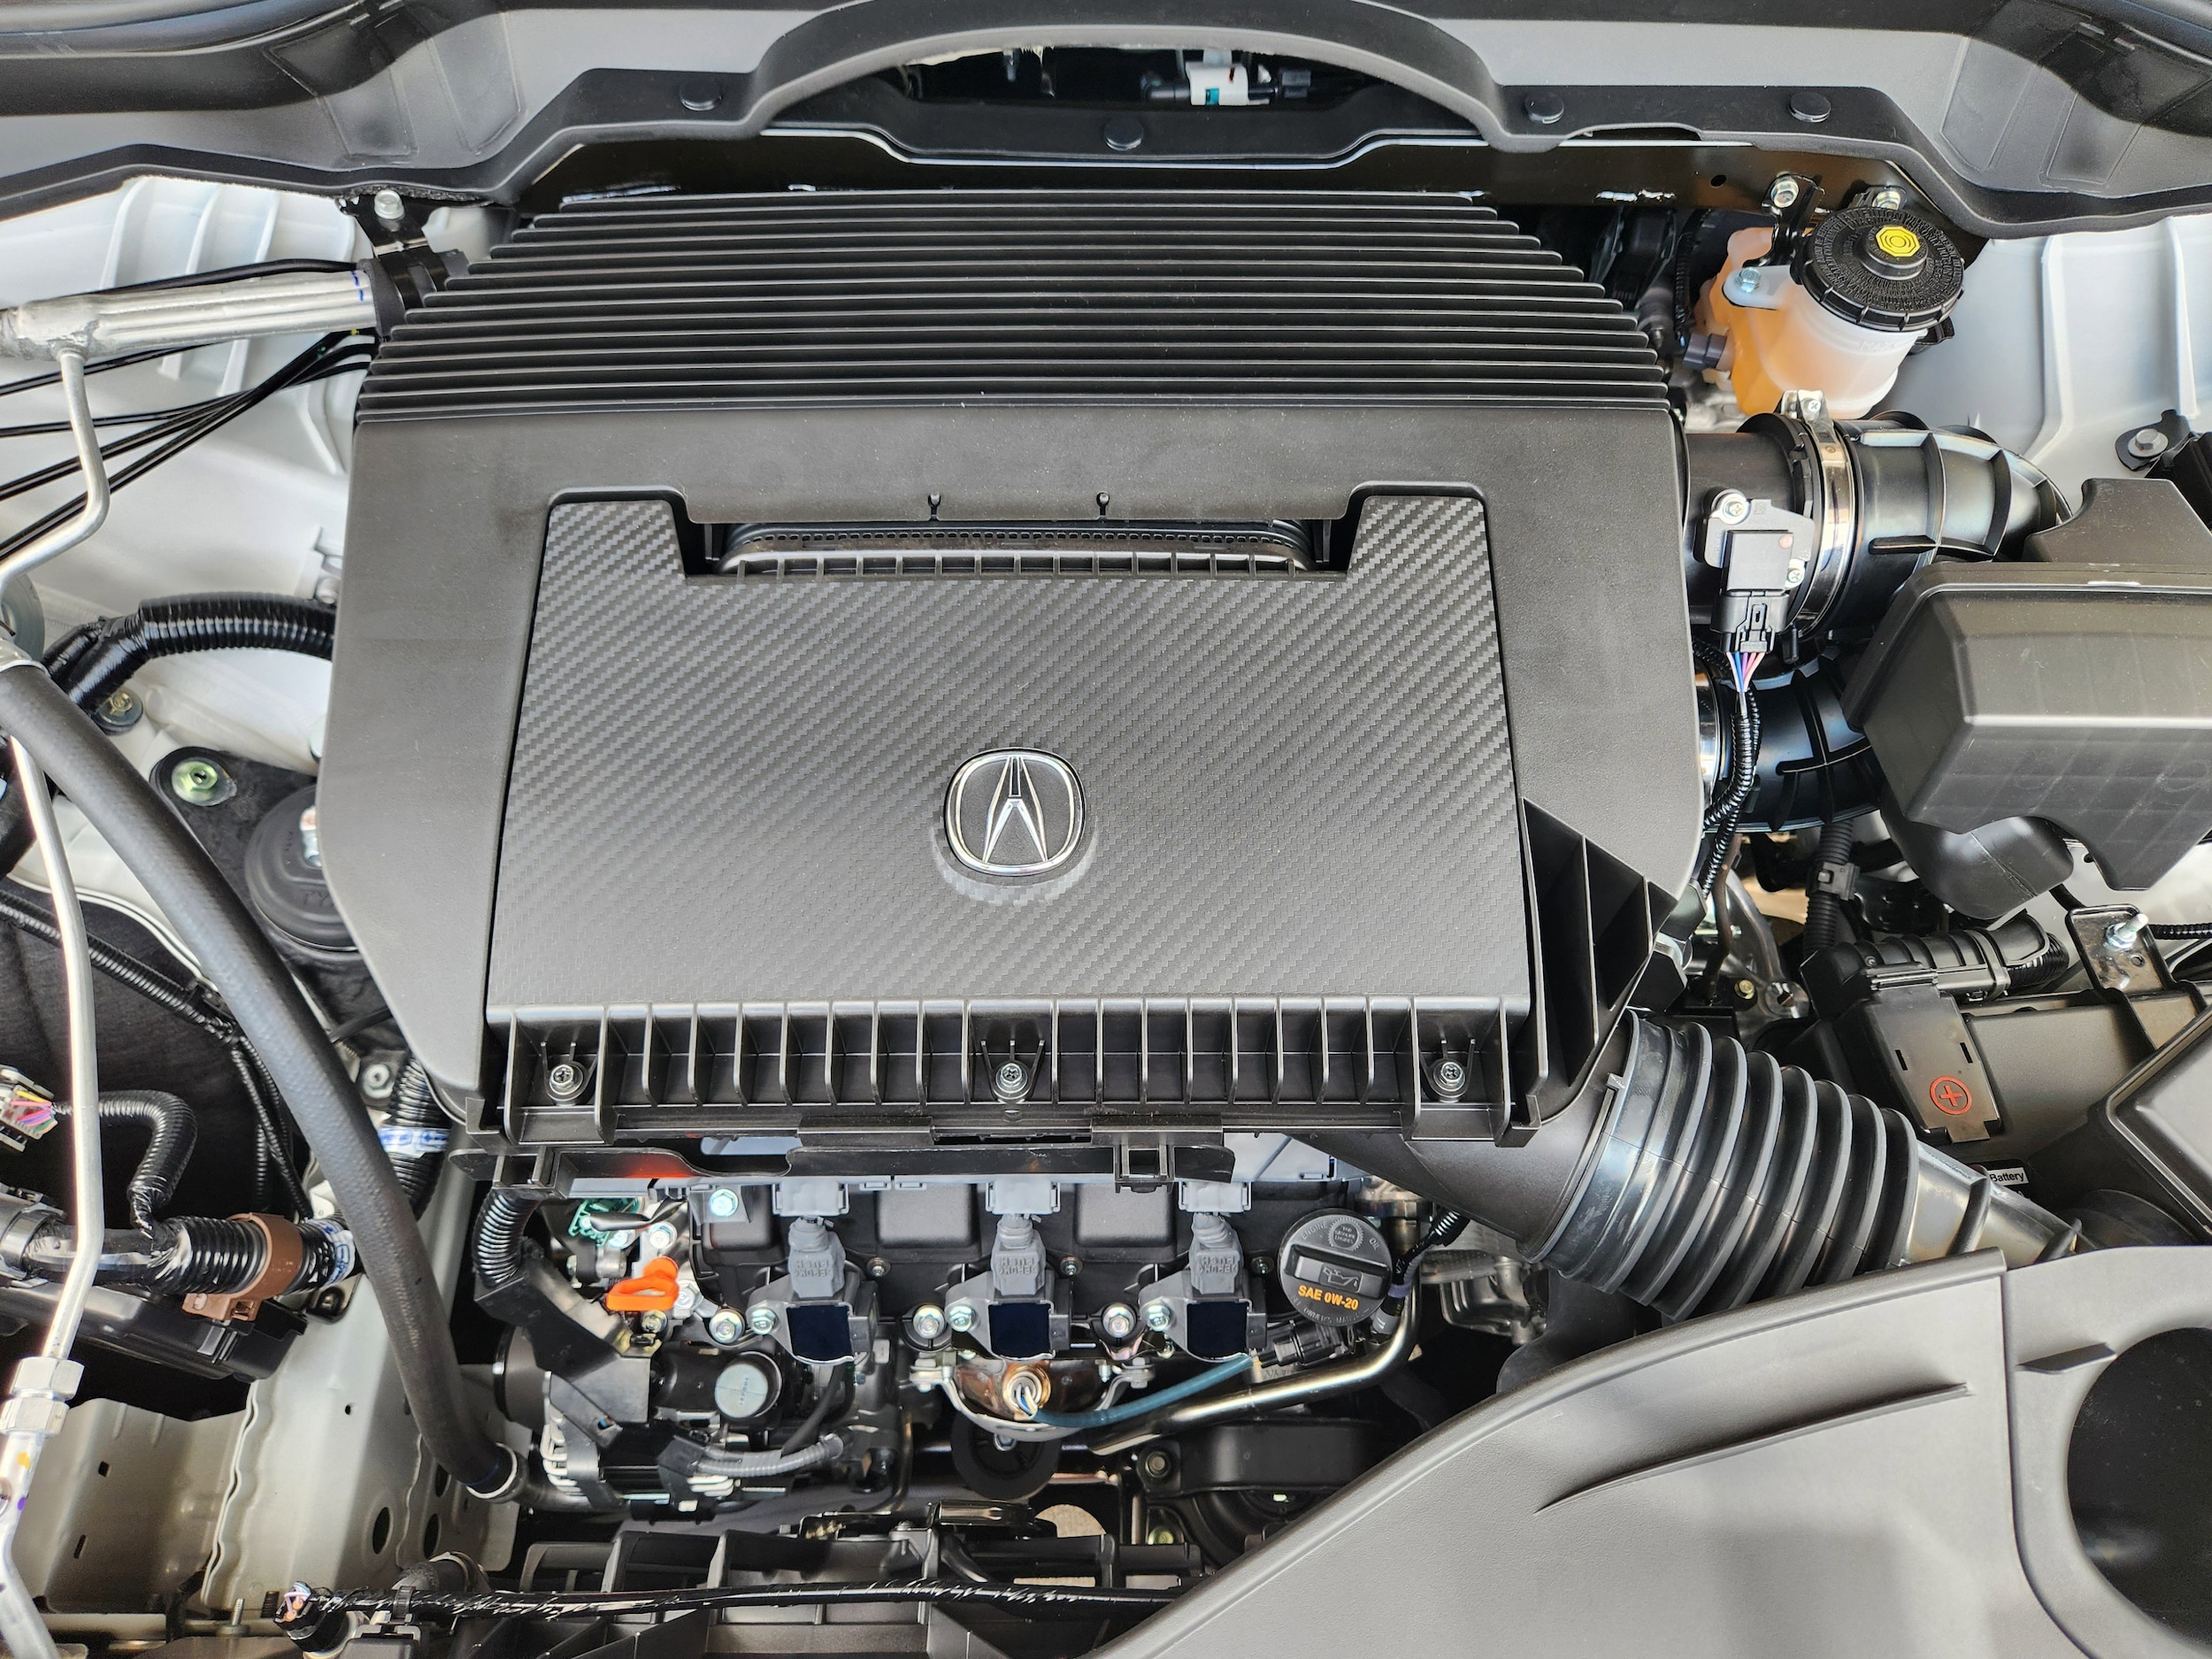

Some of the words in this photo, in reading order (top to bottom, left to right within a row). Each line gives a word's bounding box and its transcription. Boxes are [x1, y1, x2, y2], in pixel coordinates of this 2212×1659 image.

[1990, 1172, 2024, 1182] Battery
[1301, 1221, 1329, 1240] ENGINE
[1369, 1237, 1381, 1251] OIL
[1298, 1285, 1324, 1302] SAE
[1325, 1292, 1359, 1311] 0W-20
